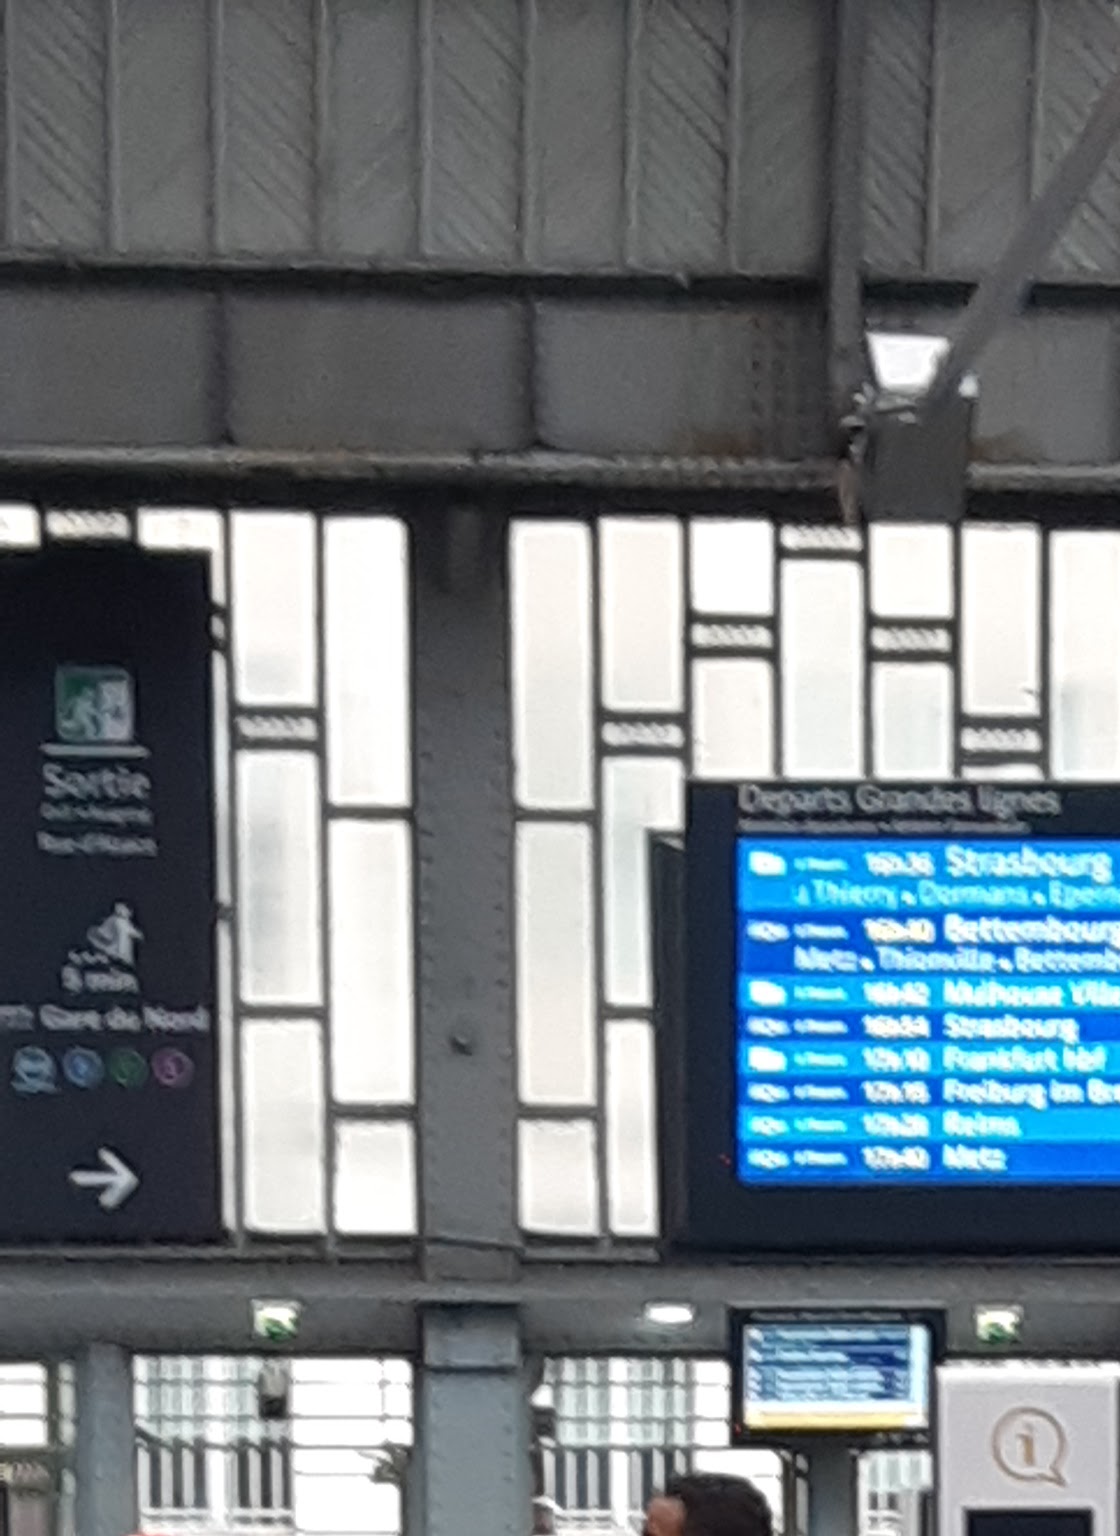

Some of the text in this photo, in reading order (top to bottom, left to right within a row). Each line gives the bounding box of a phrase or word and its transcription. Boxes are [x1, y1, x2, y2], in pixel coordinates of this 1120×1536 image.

[42, 763, 152, 799] Sortie
[856, 784, 974, 814] Grandes
[944, 844, 1113, 885] Strasbourg
[917, 879, 1029, 907] Dormans
[793, 945, 860, 973] Metz
[876, 945, 997, 973] Thionville
[943, 978, 1066, 1009] Mulhouse
[39, 1004, 102, 1032] Gare
[104, 1004, 142, 1032] du
[142, 1003, 211, 1033] Nord
[943, 1012, 1080, 1046] Strasbourg
[943, 1045, 1059, 1073] Frankfurt
[943, 1077, 1049, 1112] Freiburg
[1050, 1078, 1085, 1105] im
[943, 1110, 1023, 1139] Reims
[943, 1143, 1009, 1172] Metz
